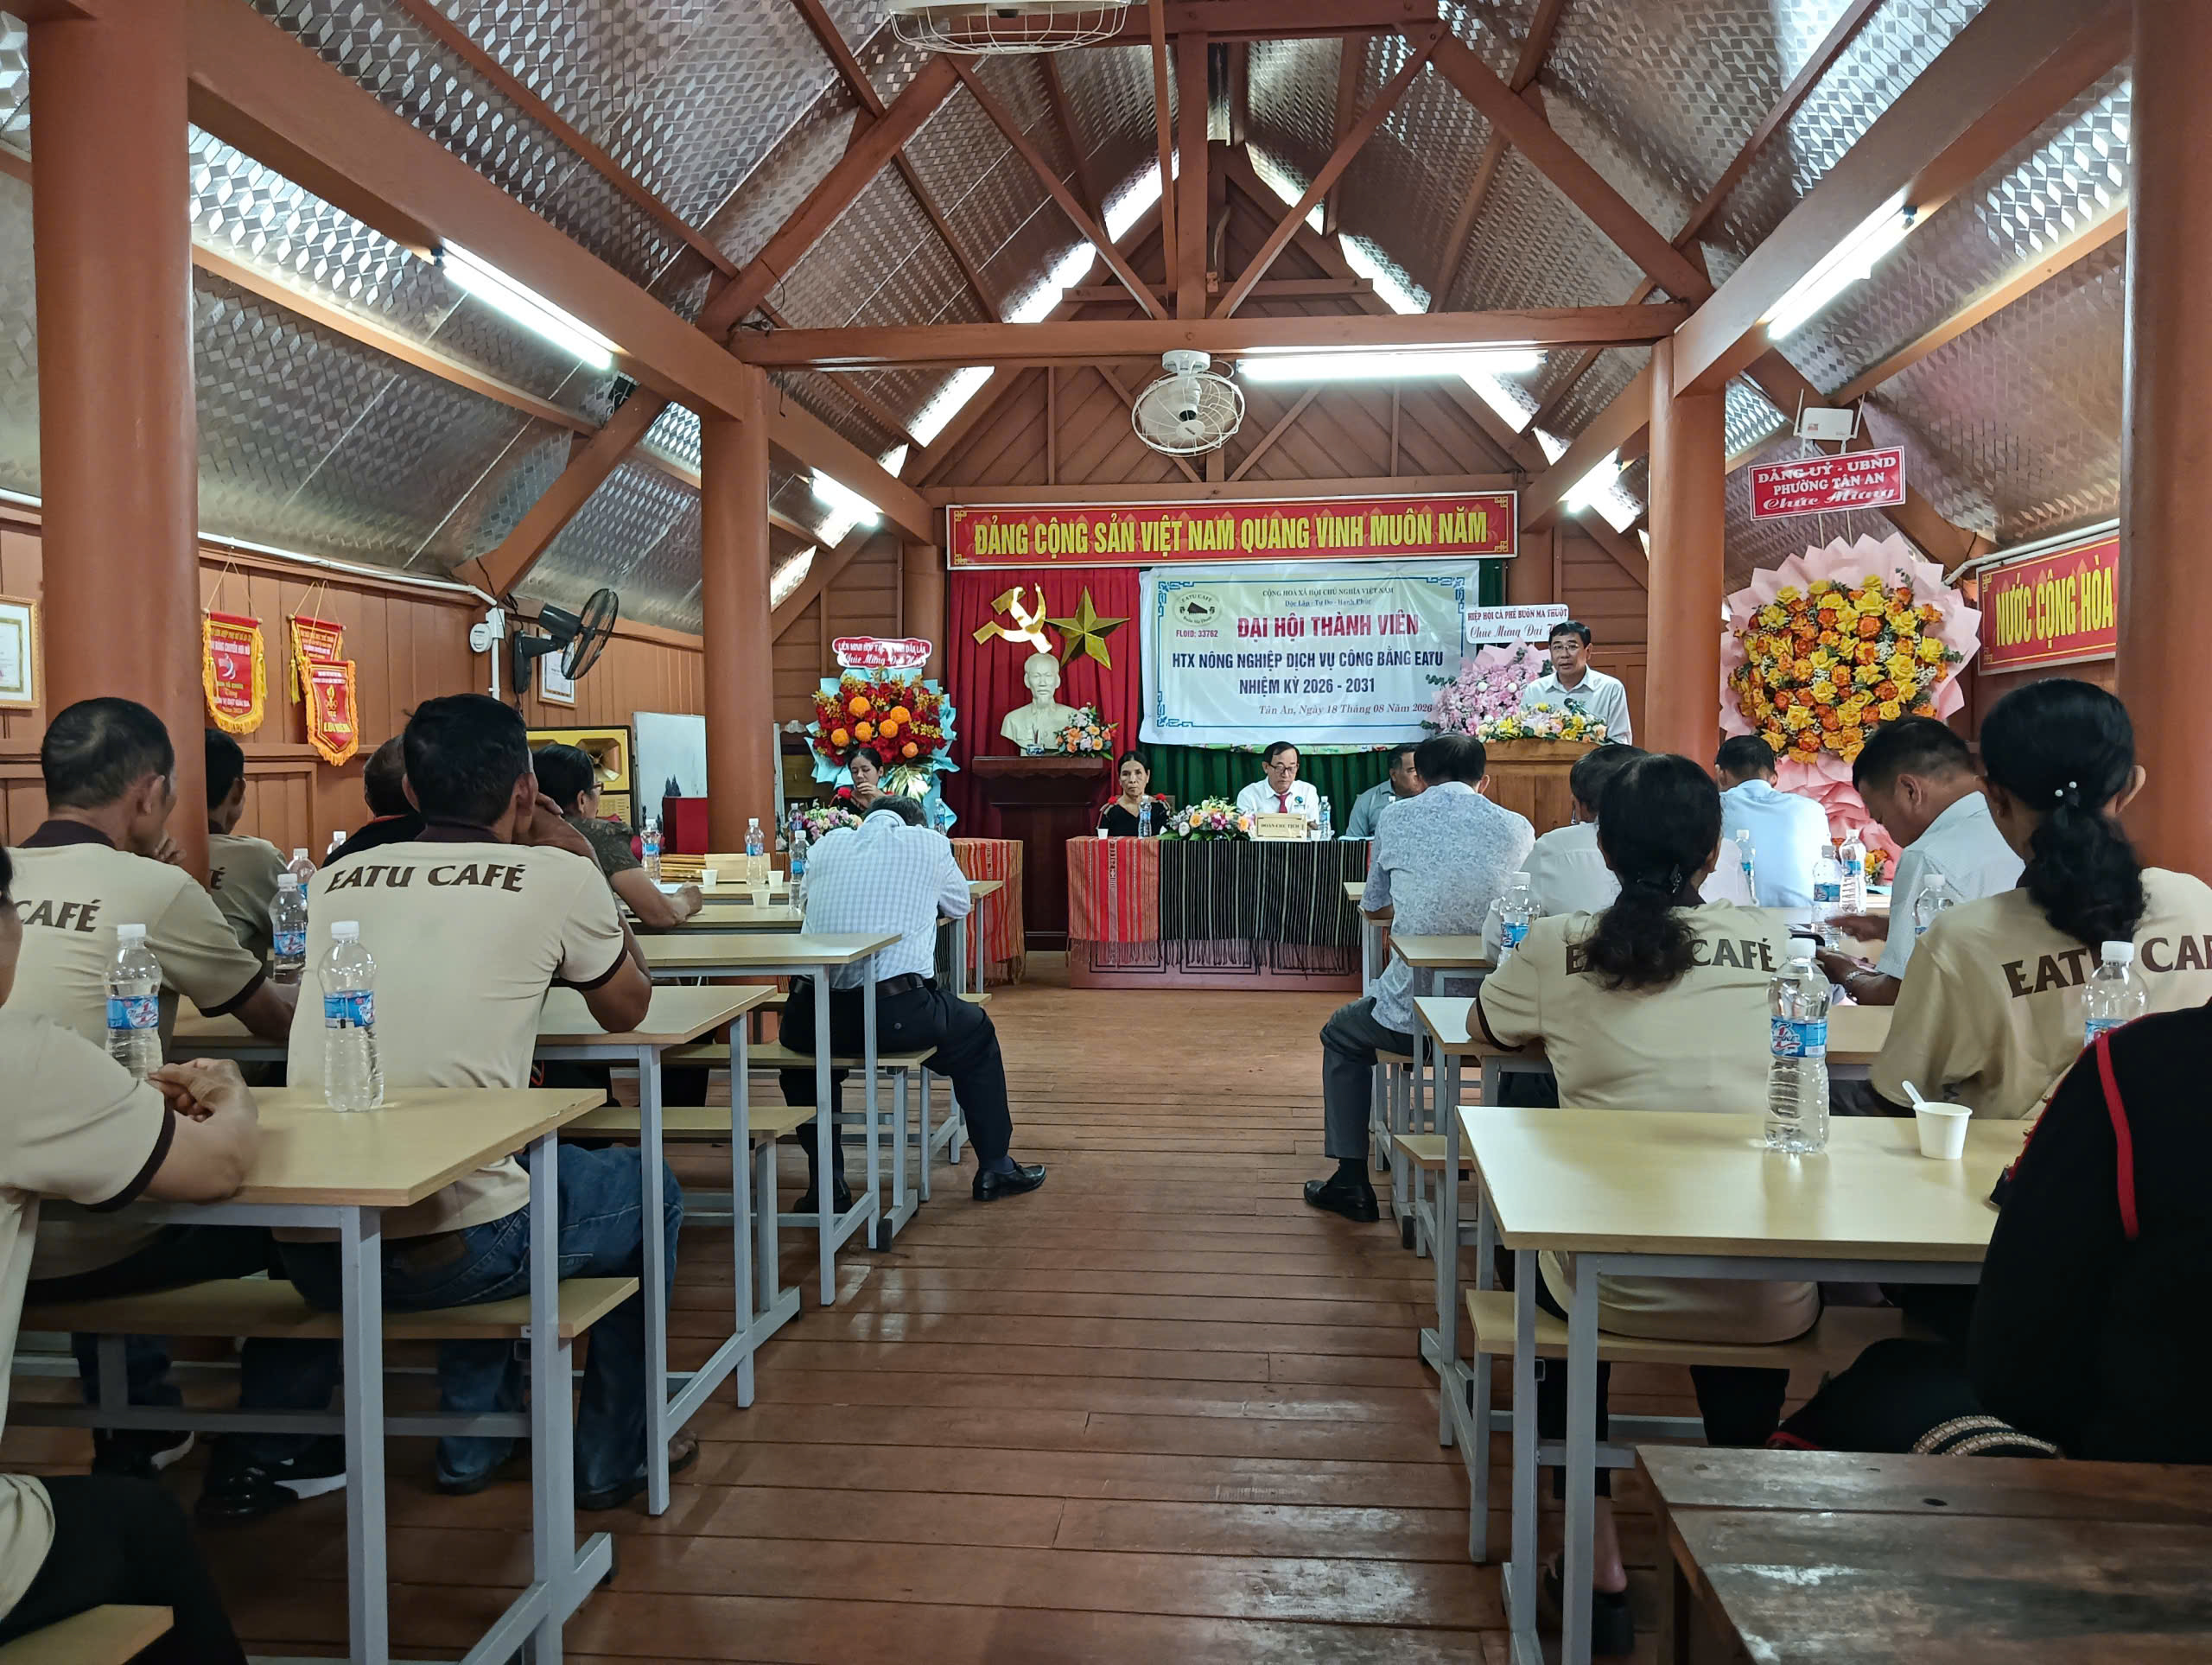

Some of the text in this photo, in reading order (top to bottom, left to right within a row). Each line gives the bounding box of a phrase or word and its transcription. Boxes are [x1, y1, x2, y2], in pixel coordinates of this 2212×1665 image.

[1847, 457, 1897, 472] UBND
[1773, 473, 1885, 496] PHƯỜNG TÂN AN
[974, 505, 1487, 559] ĐẢNG CỘNG SẢN VIỆT NAM QUANG VINH MUÔN NĂM
[1262, 588, 1282, 599] CỘNG
[1995, 554, 2114, 649] NƯỚC CỘNG HÒA
[1237, 609, 1419, 643] ĐẠI HỘI THÀNH VIÊN
[1467, 610, 1482, 622] HIỆP
[1483, 610, 1494, 620] HỘI
[1535, 609, 1546, 618] MA
[1173, 645, 1444, 671] HTX NÔNG NGHIỆP DỊCH VỤ CÔNG BẰNG EATU
[1239, 676, 1280, 697] NHIỆM
[1284, 676, 1300, 694] KỲ
[1303, 678, 1333, 694] 2026
[1345, 677, 1375, 693] 2031
[1259, 703, 1433, 715] Tân An, Ngày 18 Tháng 08 Năm 2026
[323, 863, 527, 895] EATU CAFÉ
[1687, 937, 1777, 973] CAFÉ
